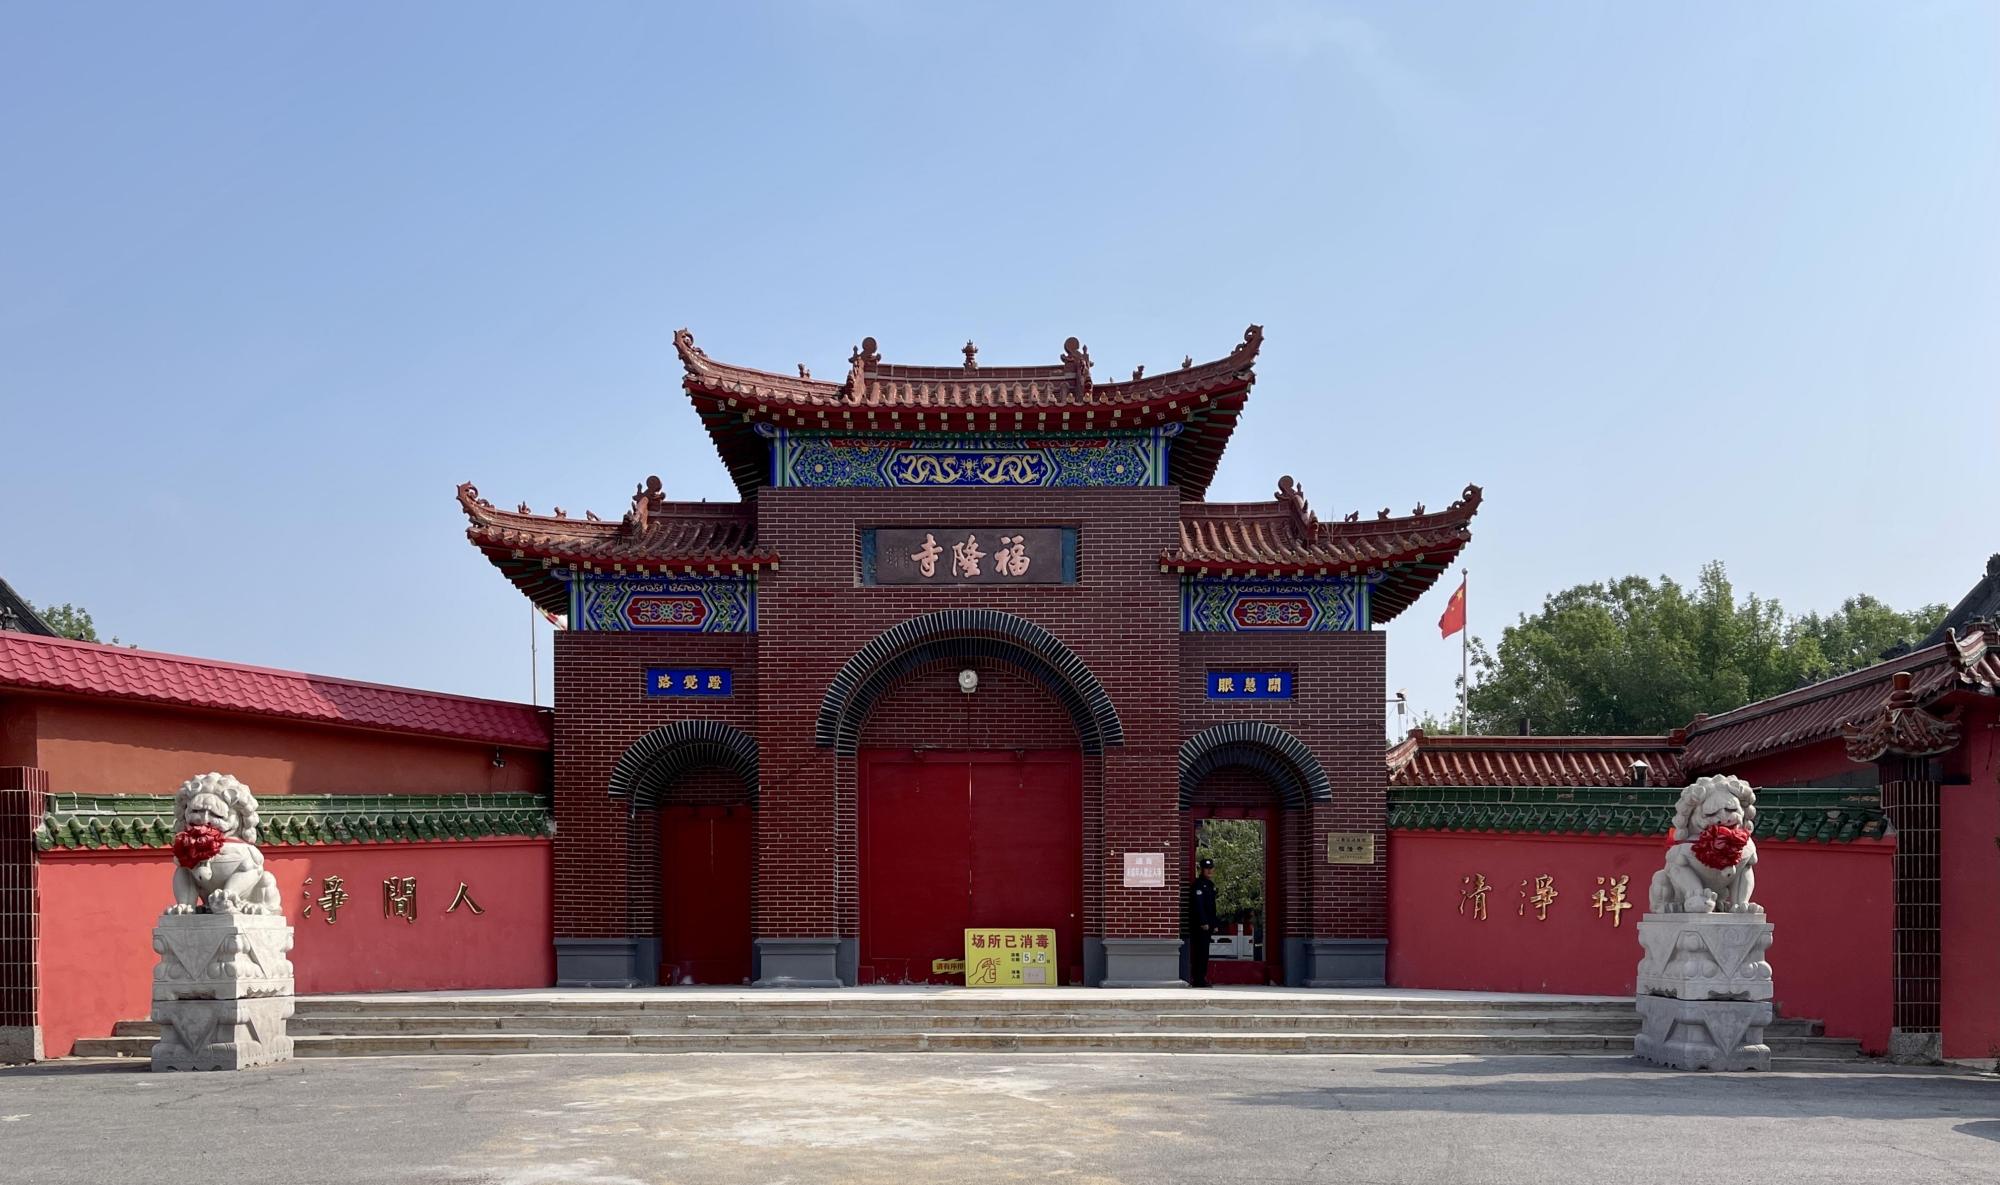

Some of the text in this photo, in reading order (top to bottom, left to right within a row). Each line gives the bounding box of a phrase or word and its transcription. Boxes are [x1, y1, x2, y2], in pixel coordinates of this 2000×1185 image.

[911, 532, 1031, 578] 福隆寺
[1217, 677, 1282, 693] 開慧眼
[971, 934, 1050, 949] 场所已消毒
